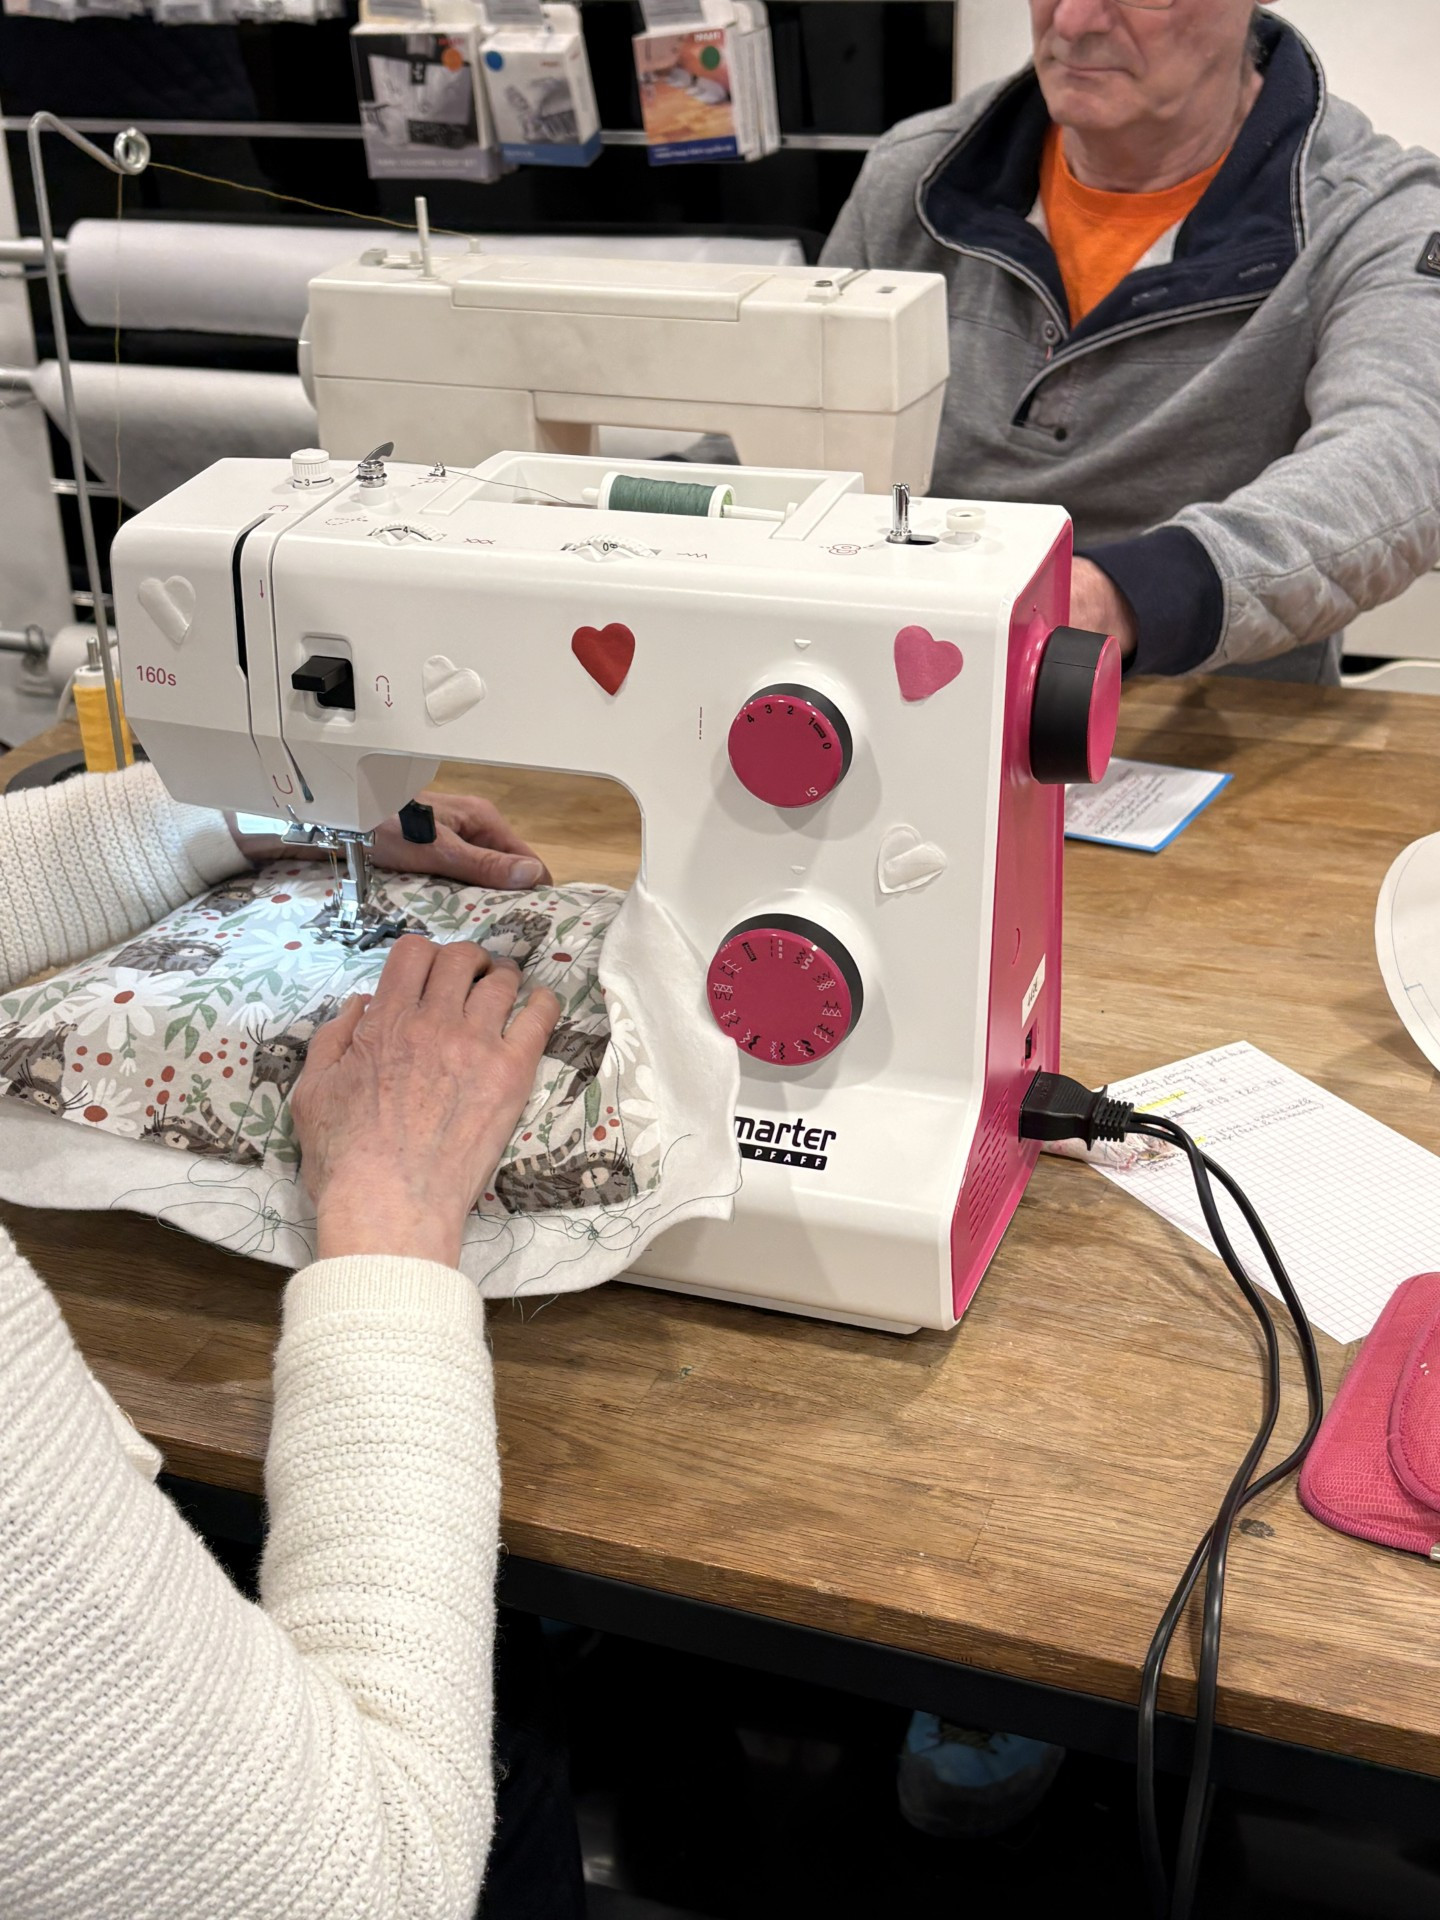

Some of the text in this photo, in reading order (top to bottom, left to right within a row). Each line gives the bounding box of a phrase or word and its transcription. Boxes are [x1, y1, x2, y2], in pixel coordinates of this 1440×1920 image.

[402, 526, 409, 534] 4
[136, 664, 177, 687] 160s
[746, 704, 832, 750] 4 3 2 1 0
[734, 1115, 837, 1151] marter
[754, 1148, 823, 1168] PFAFF
